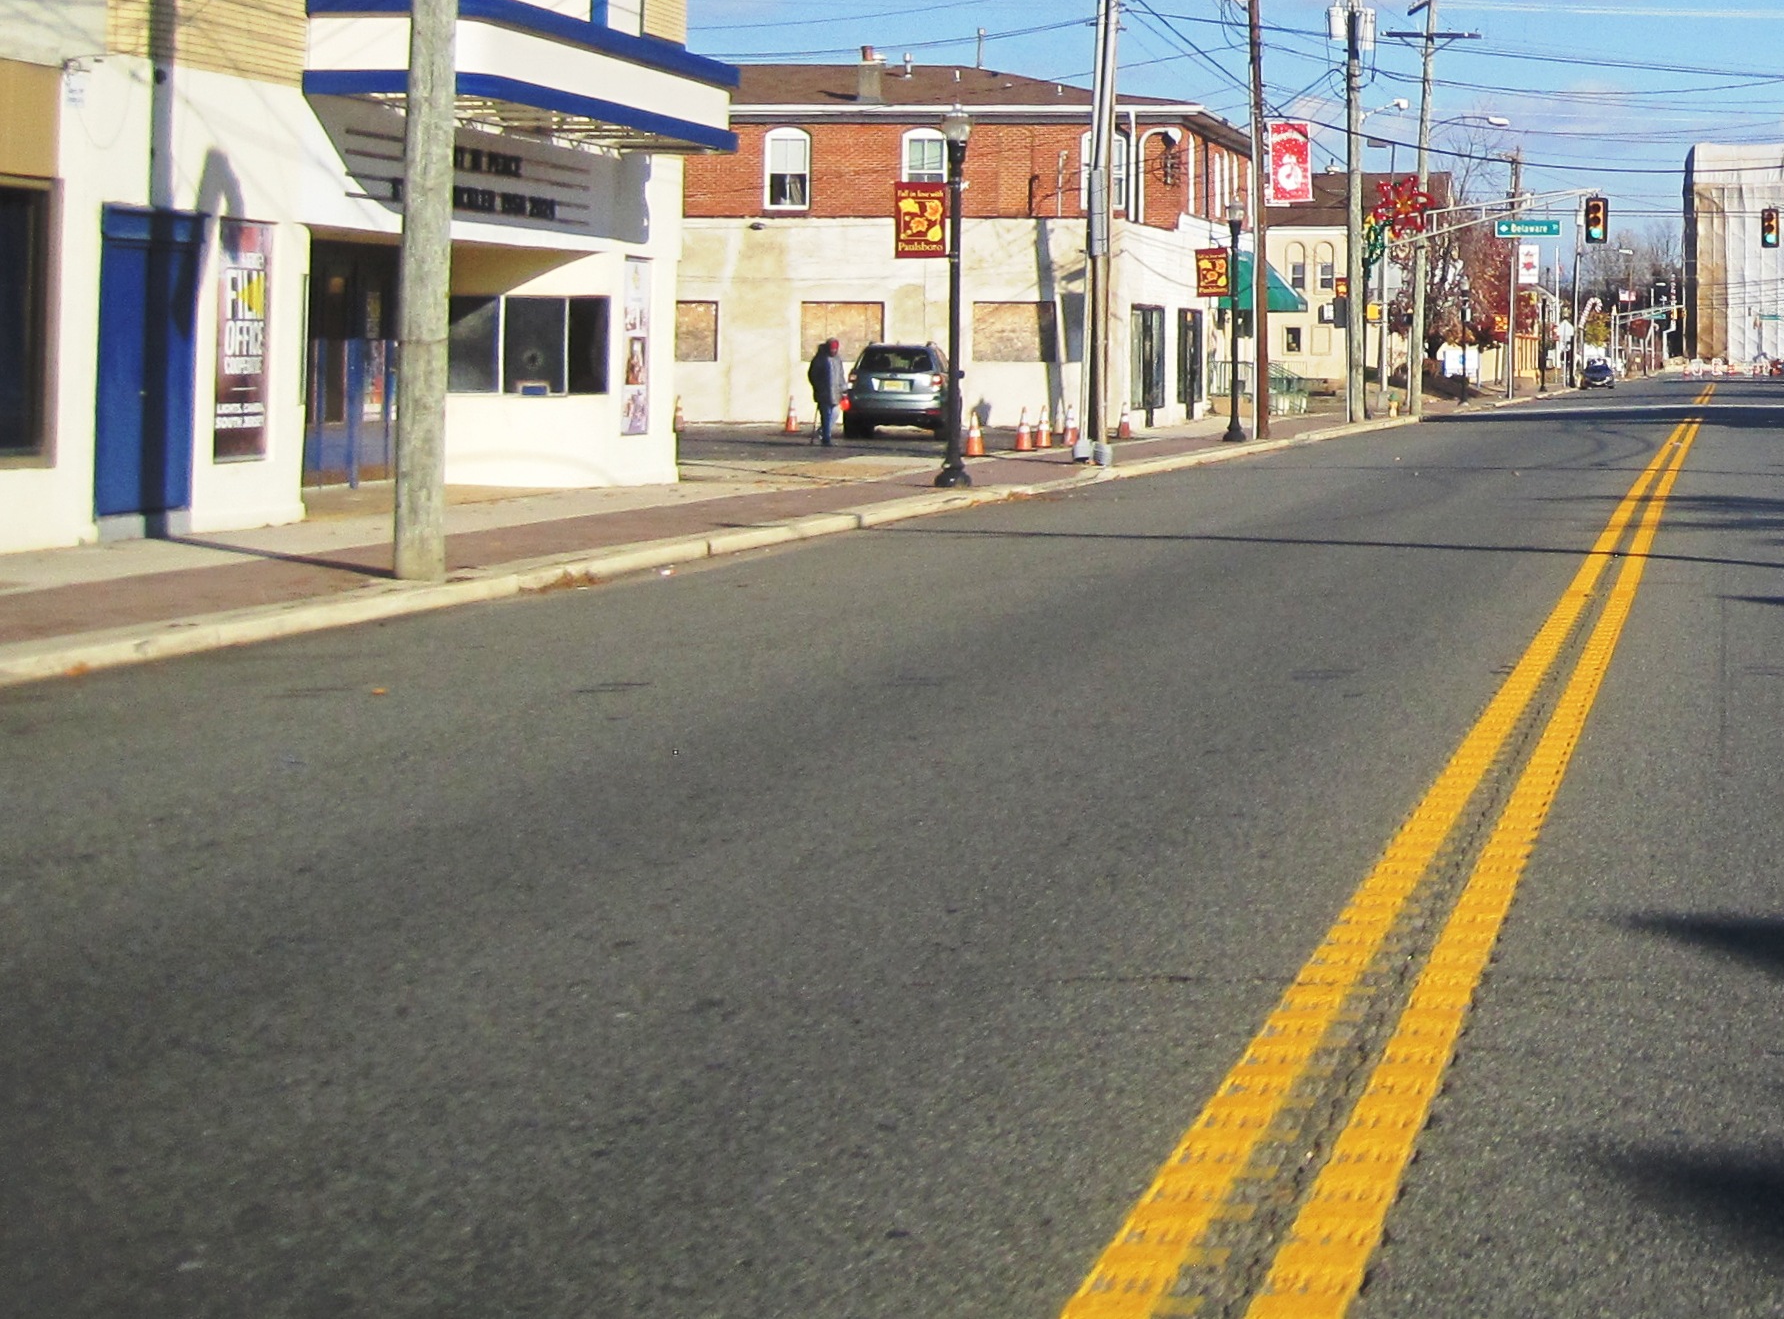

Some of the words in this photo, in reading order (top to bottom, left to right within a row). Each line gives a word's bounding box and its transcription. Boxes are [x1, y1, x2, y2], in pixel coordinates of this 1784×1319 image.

[1510, 223, 1548, 233] Delaware
[898, 241, 943, 251] Paulsboro
[225, 269, 266, 320] FILM
[224, 321, 265, 356] OFFICE
